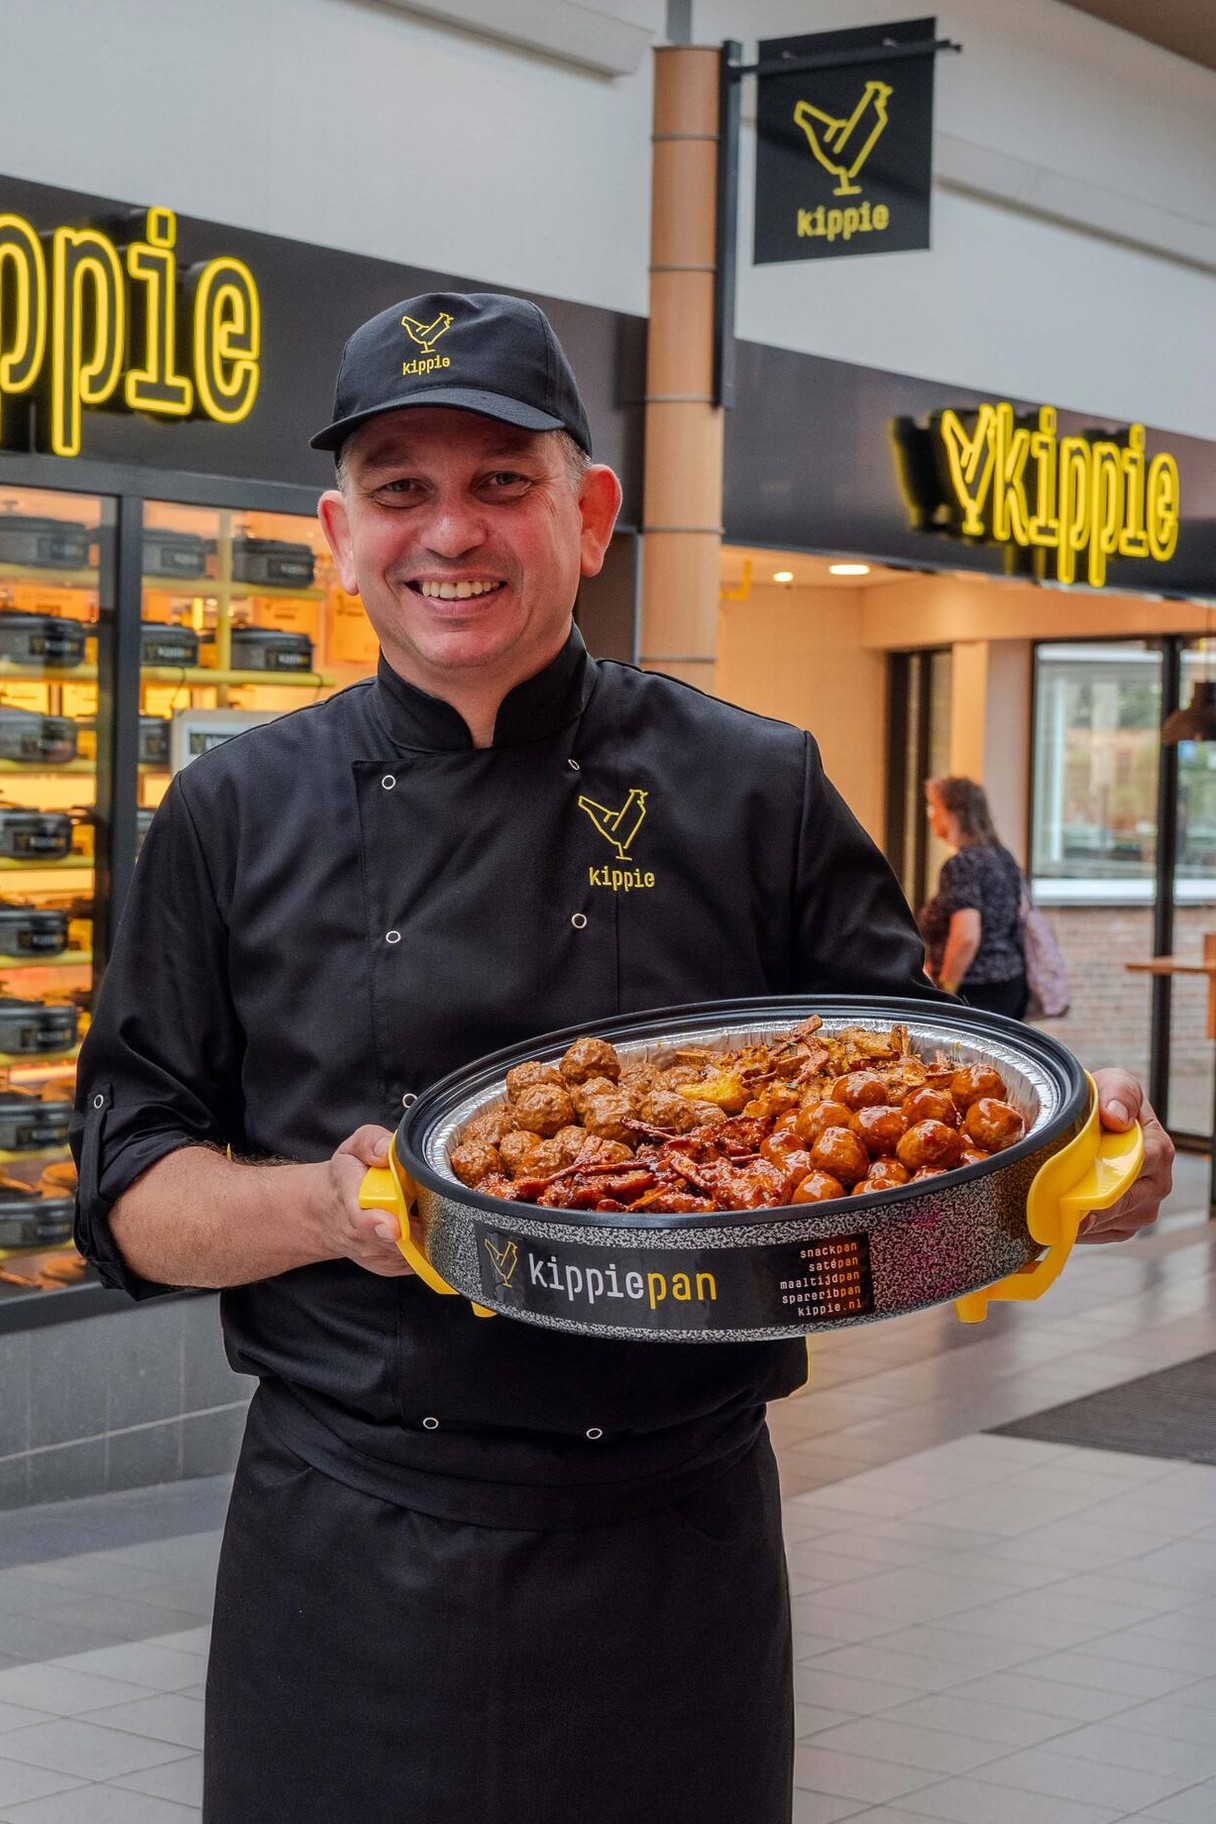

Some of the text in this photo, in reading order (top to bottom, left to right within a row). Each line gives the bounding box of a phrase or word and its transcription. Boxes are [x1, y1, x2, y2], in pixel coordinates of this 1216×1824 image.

[797, 201, 890, 241] kippie
[402, 355, 451, 375] kippie
[993, 402, 1179, 587] kippie
[589, 866, 655, 892] kippie
[800, 1242, 857, 1258] snackpan
[809, 1256, 858, 1272] satépan
[528, 1252, 716, 1309] kippiepan
[780, 1271, 860, 1290] maaltijdpan
[782, 1285, 861, 1304] spareribpan
[798, 1298, 862, 1316] kippie.nl
